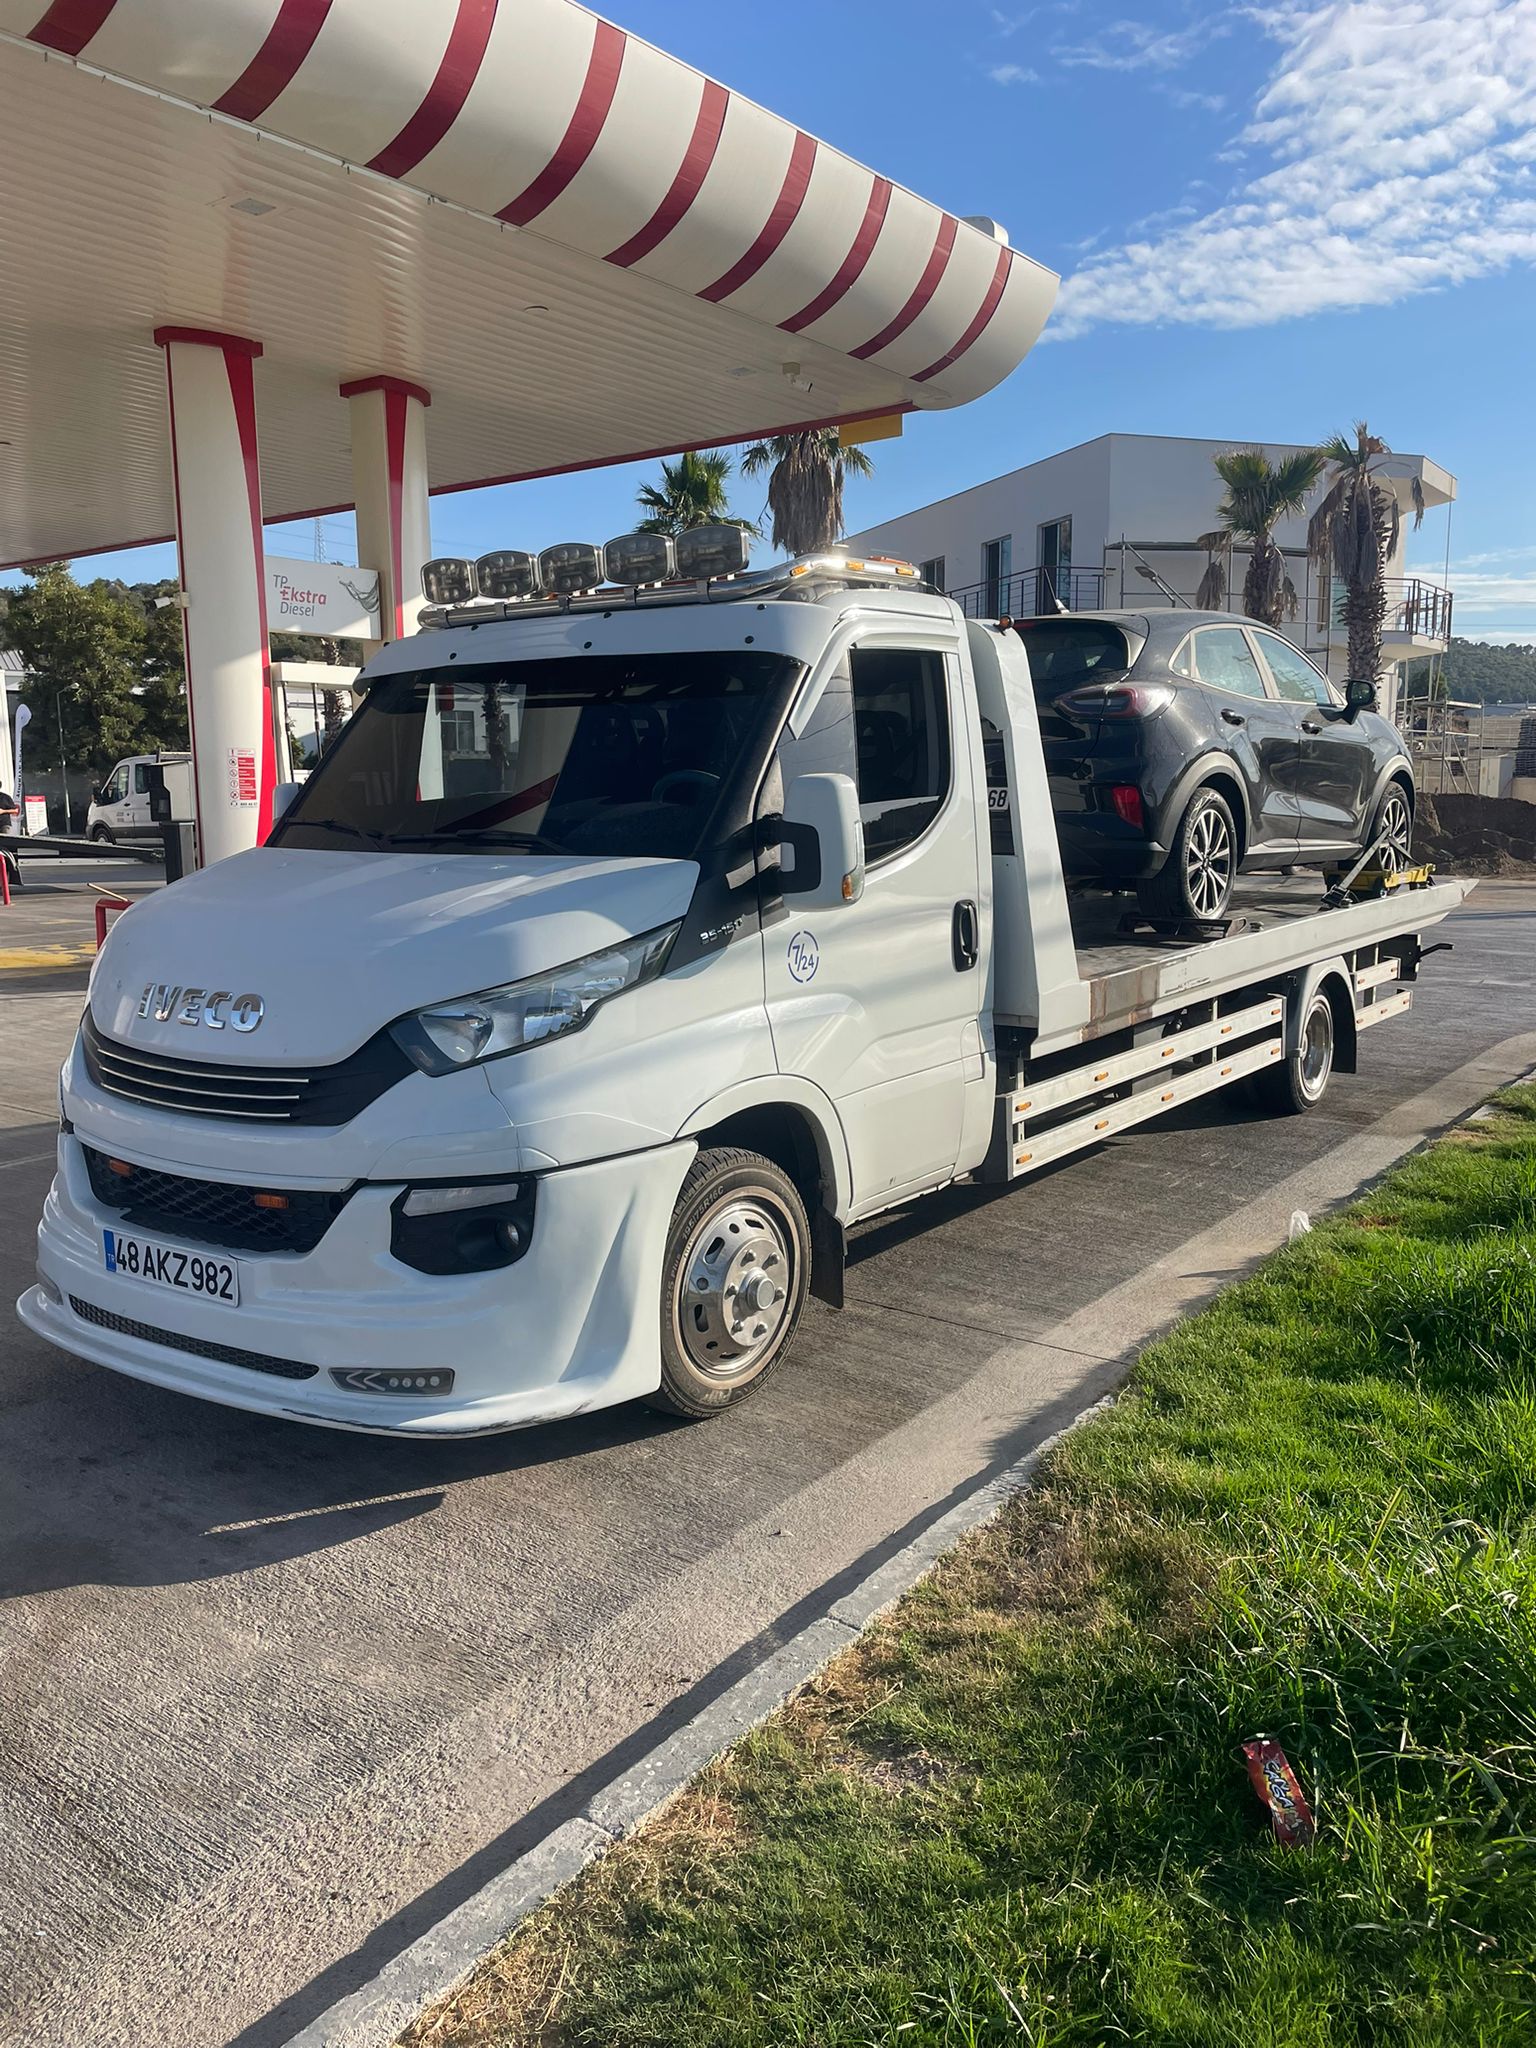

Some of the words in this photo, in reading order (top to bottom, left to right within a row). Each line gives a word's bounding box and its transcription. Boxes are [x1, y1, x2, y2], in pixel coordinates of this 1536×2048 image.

[273, 574, 288, 588] TP
[280, 586, 327, 605] Ekstra
[280, 601, 315, 617] Diesel
[792, 943, 815, 972] 7/24
[138, 982, 265, 1033] IVECO
